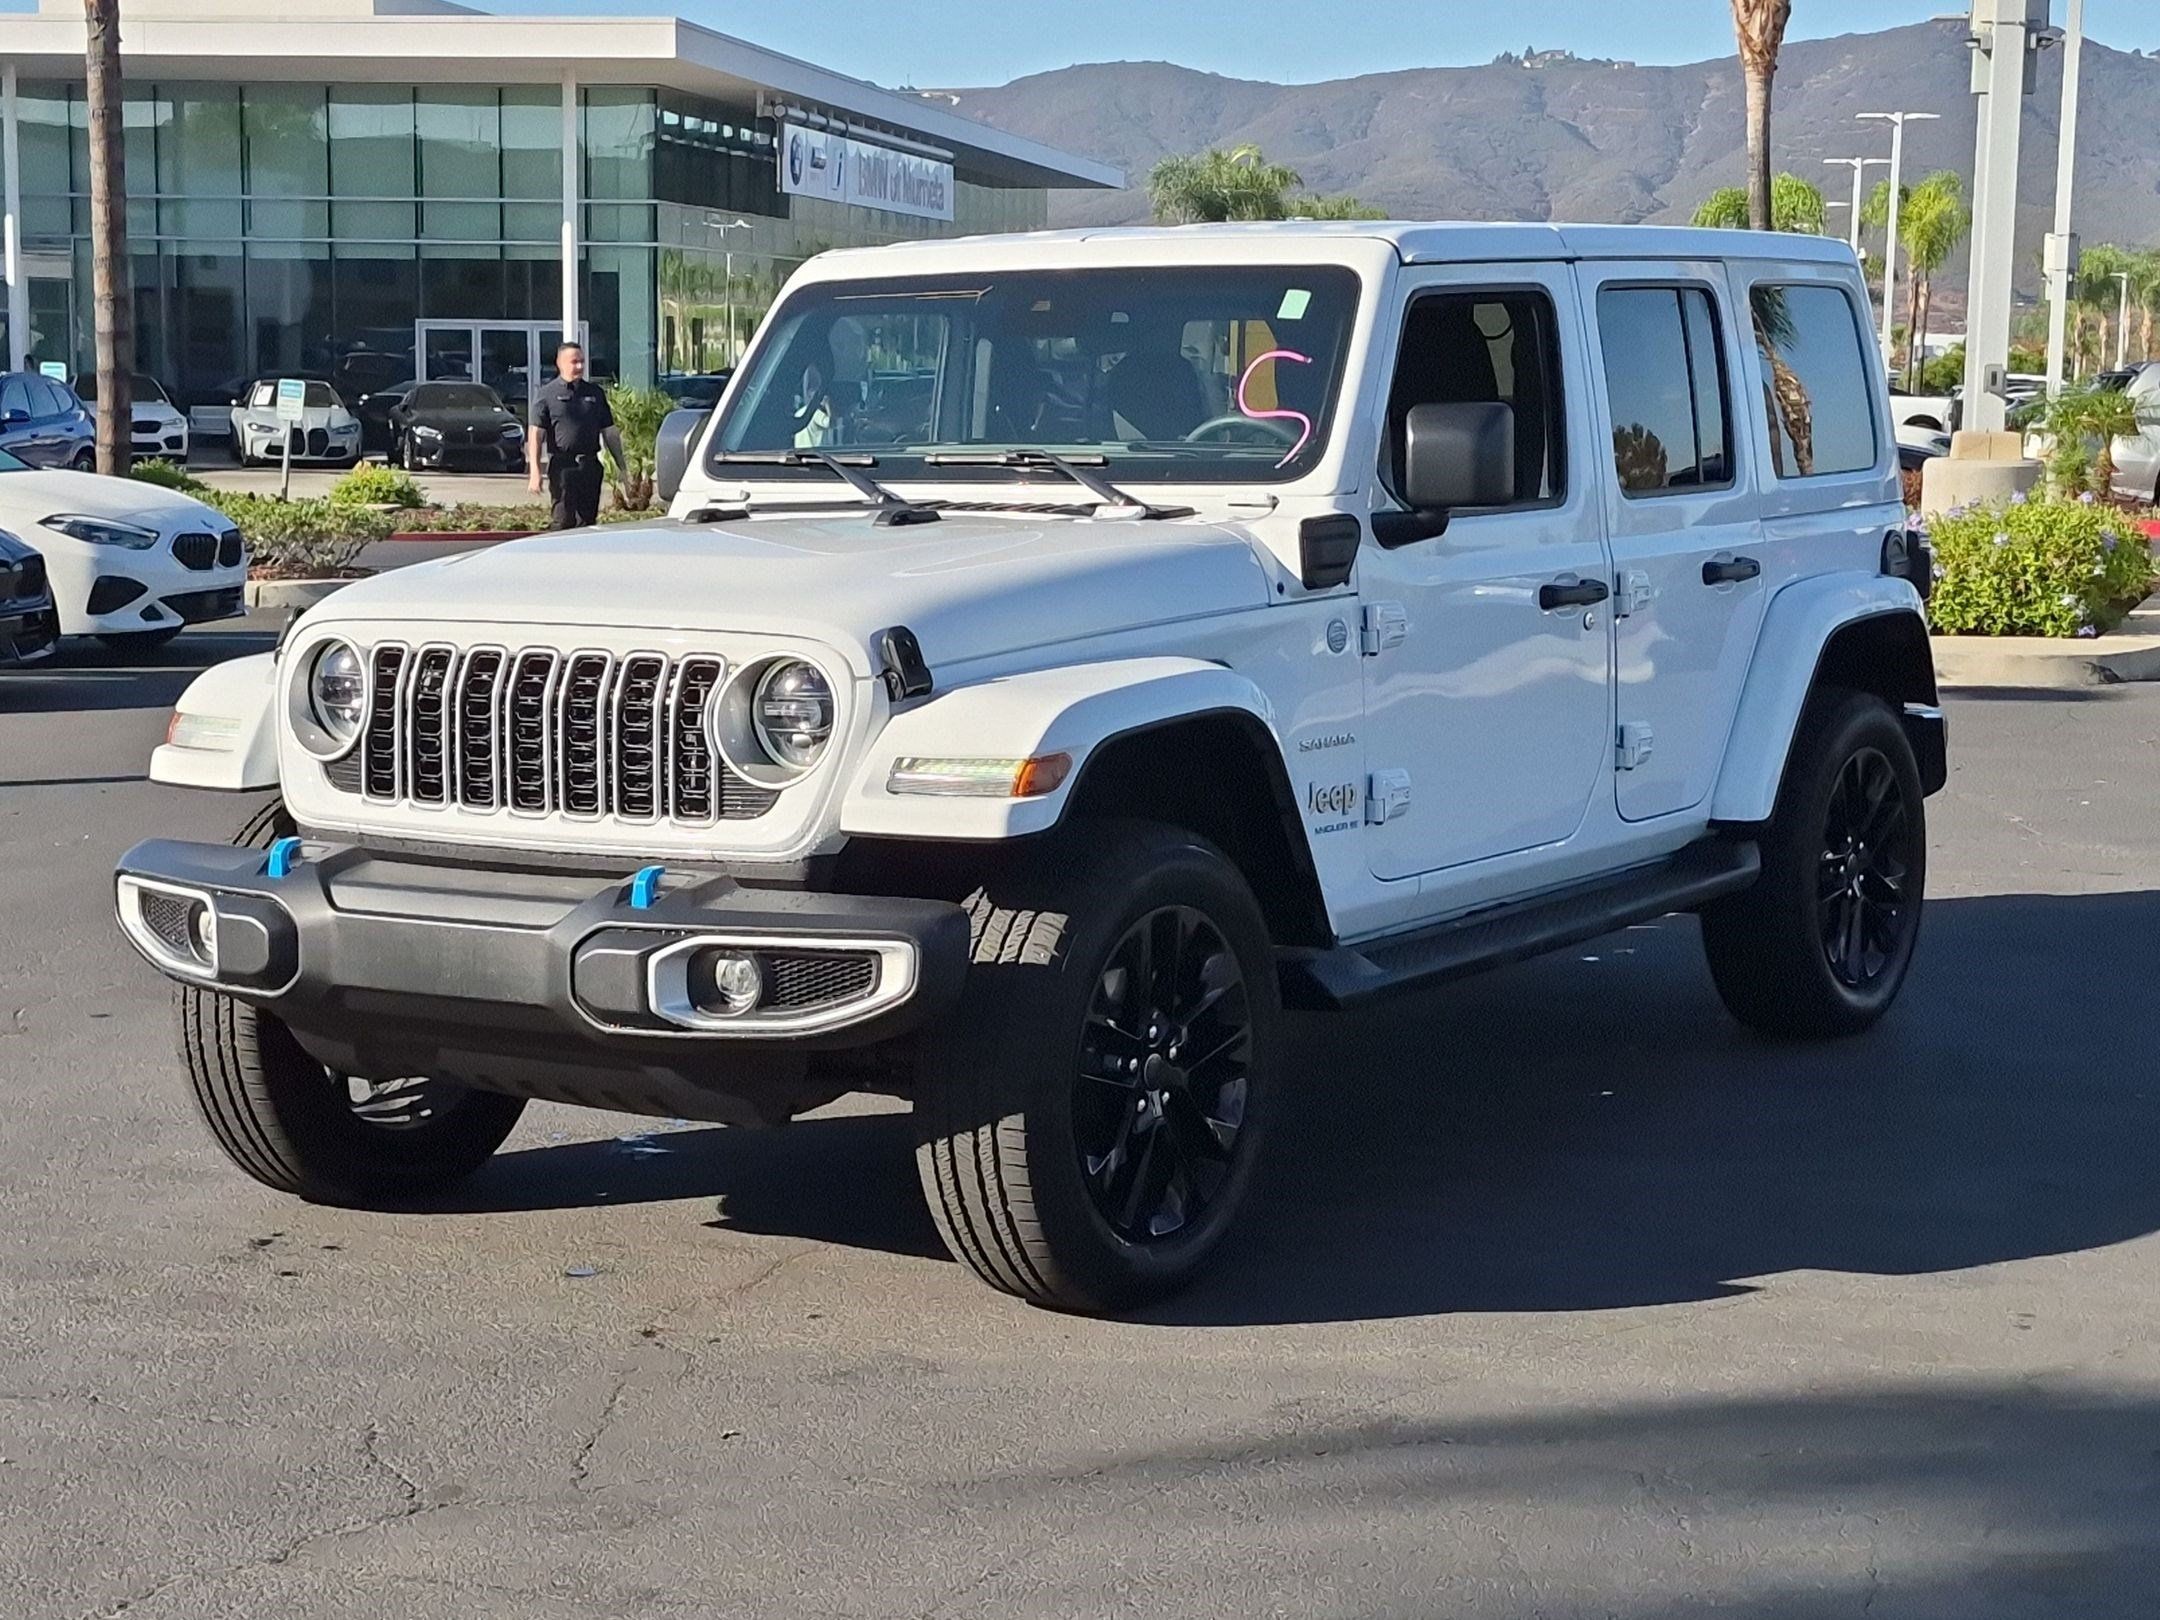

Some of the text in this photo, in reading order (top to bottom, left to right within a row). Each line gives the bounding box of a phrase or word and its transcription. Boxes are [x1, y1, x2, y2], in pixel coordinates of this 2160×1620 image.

[858, 155, 888, 200] BMW
[890, 162, 902, 202] of
[1308, 782, 1357, 816] Jeep
